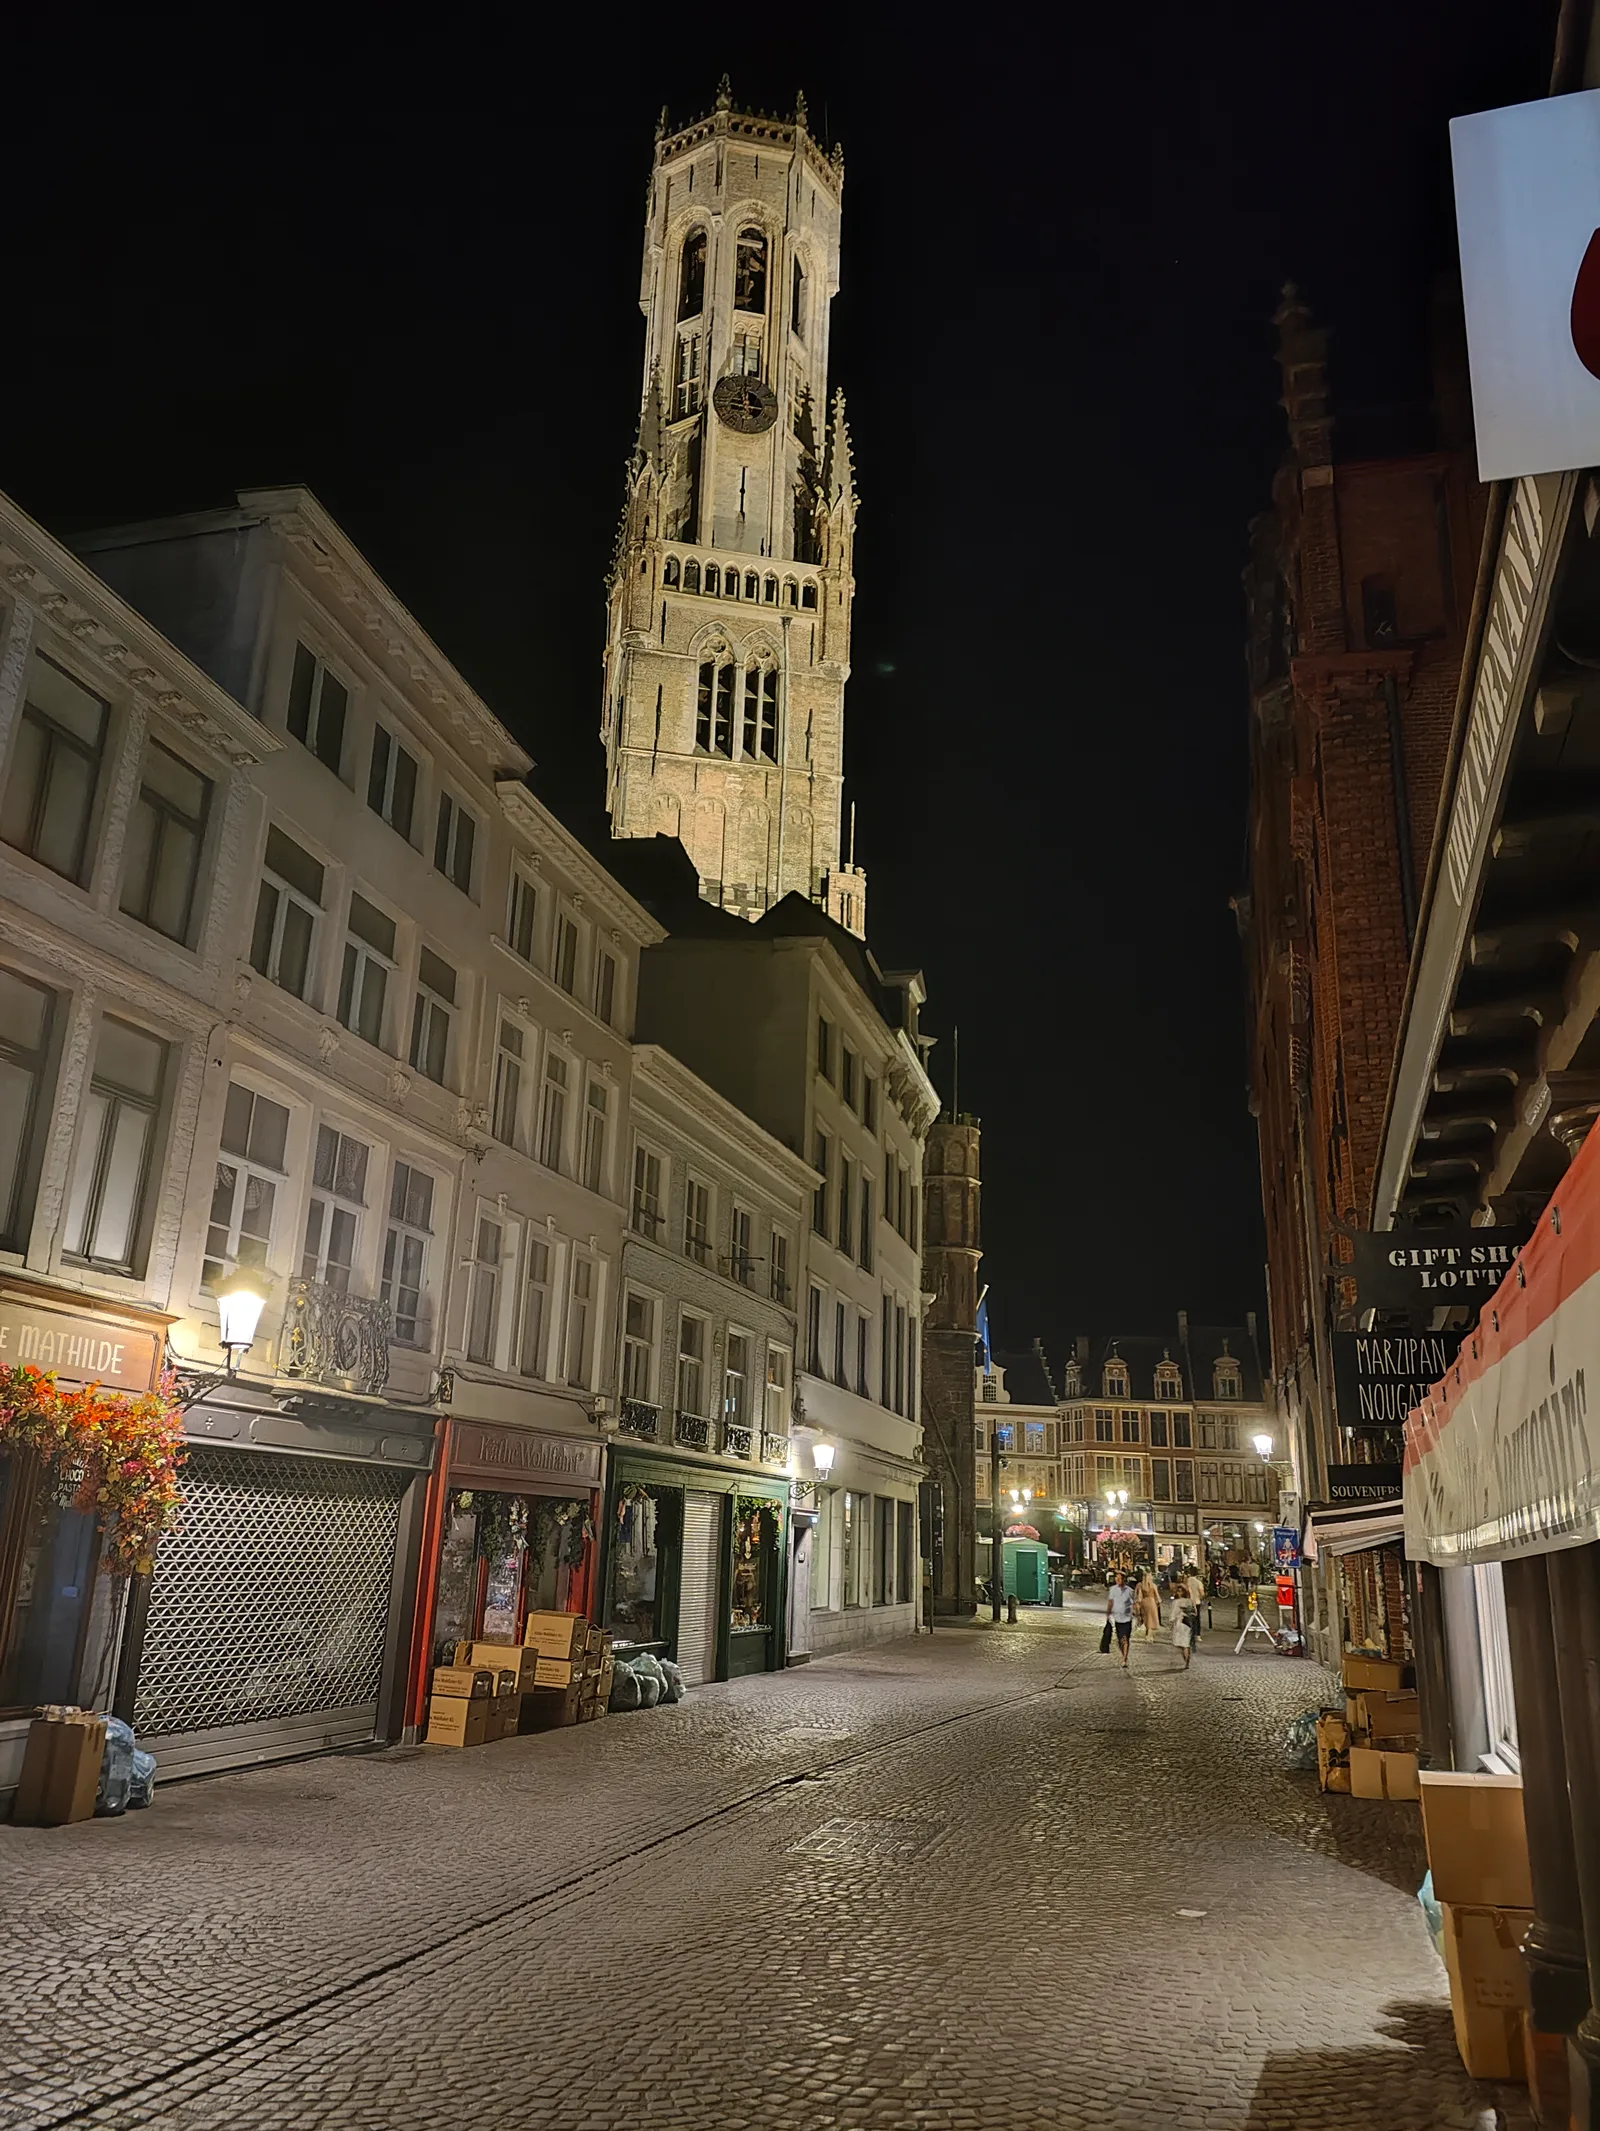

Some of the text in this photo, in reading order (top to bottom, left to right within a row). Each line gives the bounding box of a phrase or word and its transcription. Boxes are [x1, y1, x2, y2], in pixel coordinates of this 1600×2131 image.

[1447, 475, 1544, 907] CHEZ FERNAND
[1388, 1248, 1462, 1267] GIFT
[1420, 1269, 1508, 1289] LOTT
[17, 1324, 126, 1375] MATHILDE
[1356, 1338, 1447, 1375] MARZIPAN
